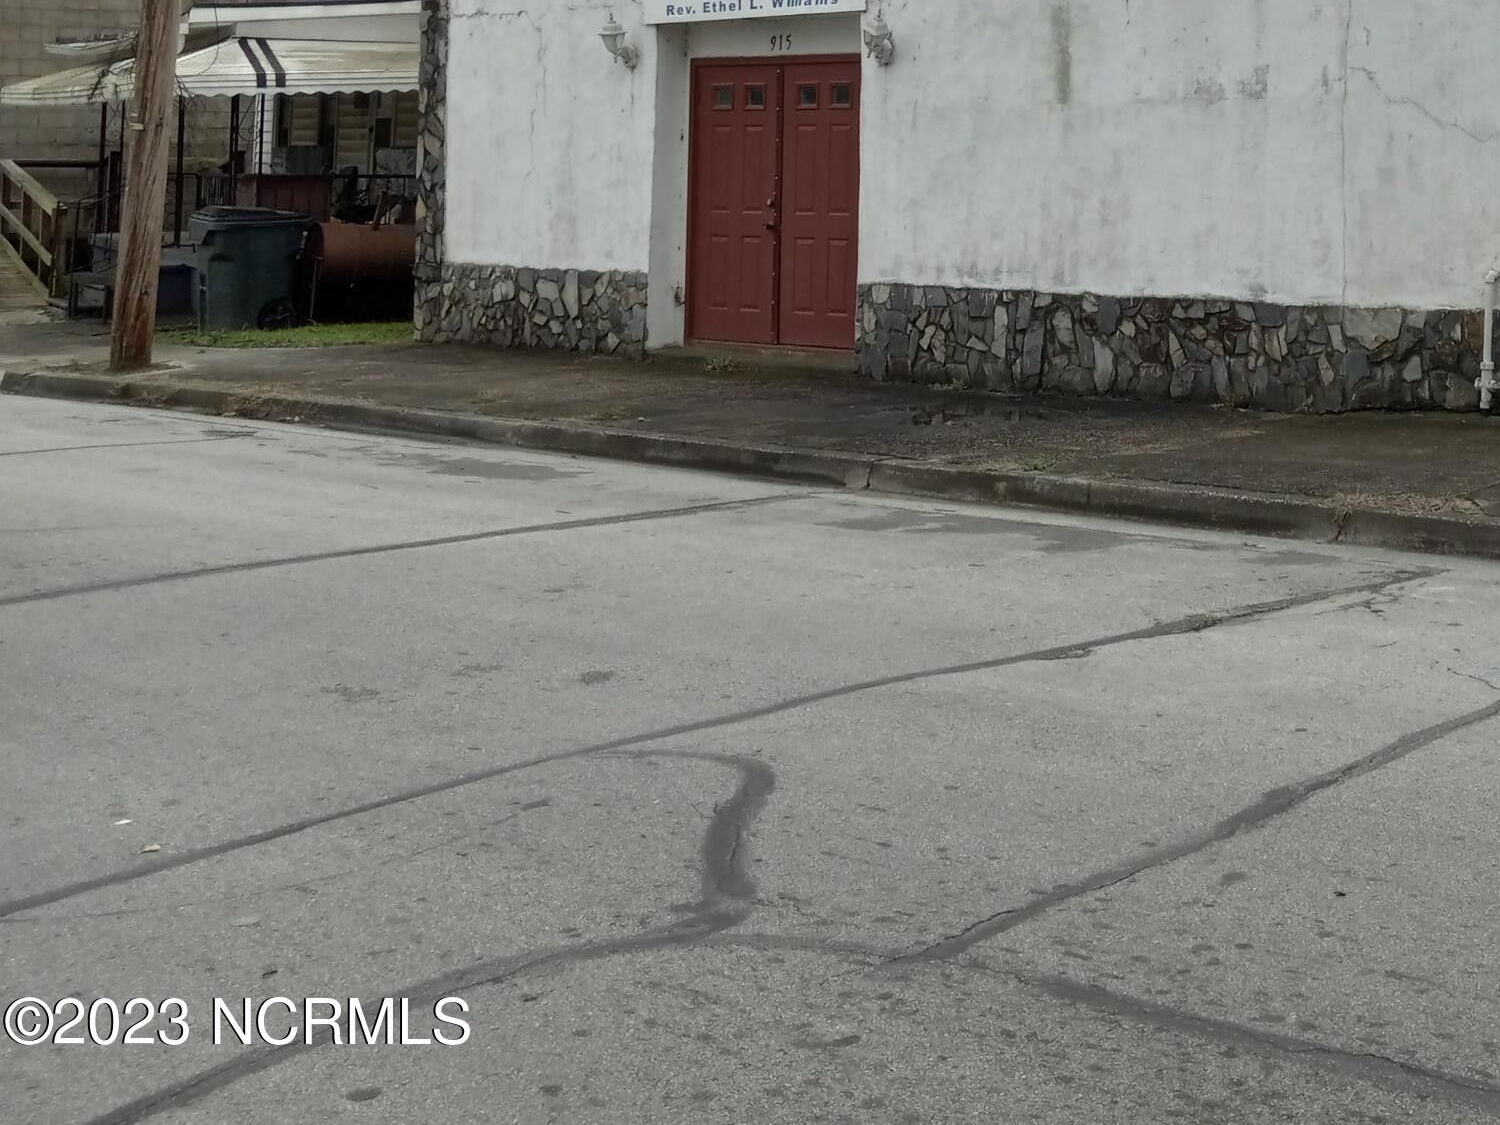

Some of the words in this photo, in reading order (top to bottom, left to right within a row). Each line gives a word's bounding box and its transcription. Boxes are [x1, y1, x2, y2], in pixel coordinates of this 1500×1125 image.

[666, 4, 696, 16] Rev.
[703, 0, 742, 13] Ethel
[770, 34, 792, 51] 915
